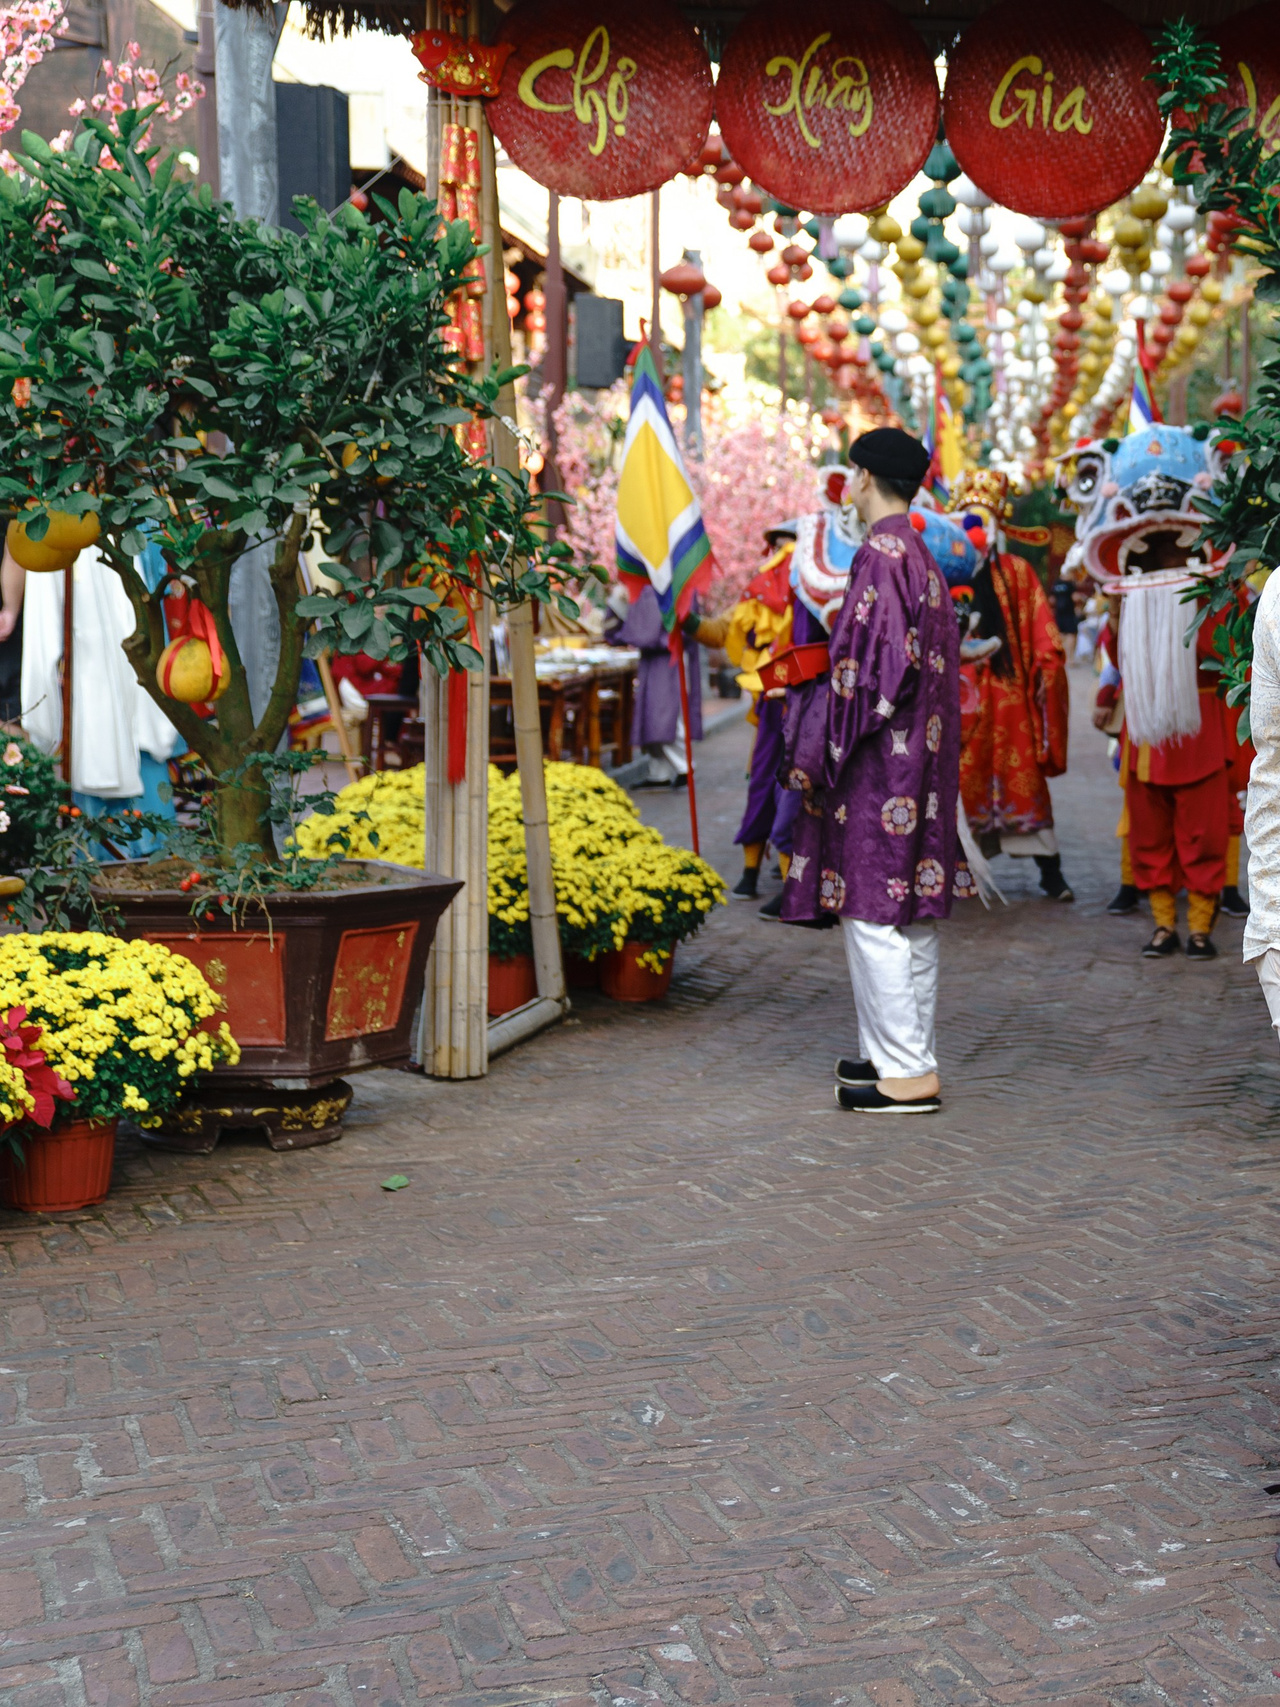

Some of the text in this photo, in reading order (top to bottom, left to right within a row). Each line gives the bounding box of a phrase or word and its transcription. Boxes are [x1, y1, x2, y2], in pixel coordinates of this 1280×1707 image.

[517, 26, 637, 156] Chợ
[762, 32, 874, 148] Xuân
[989, 56, 1094, 135] Gia
